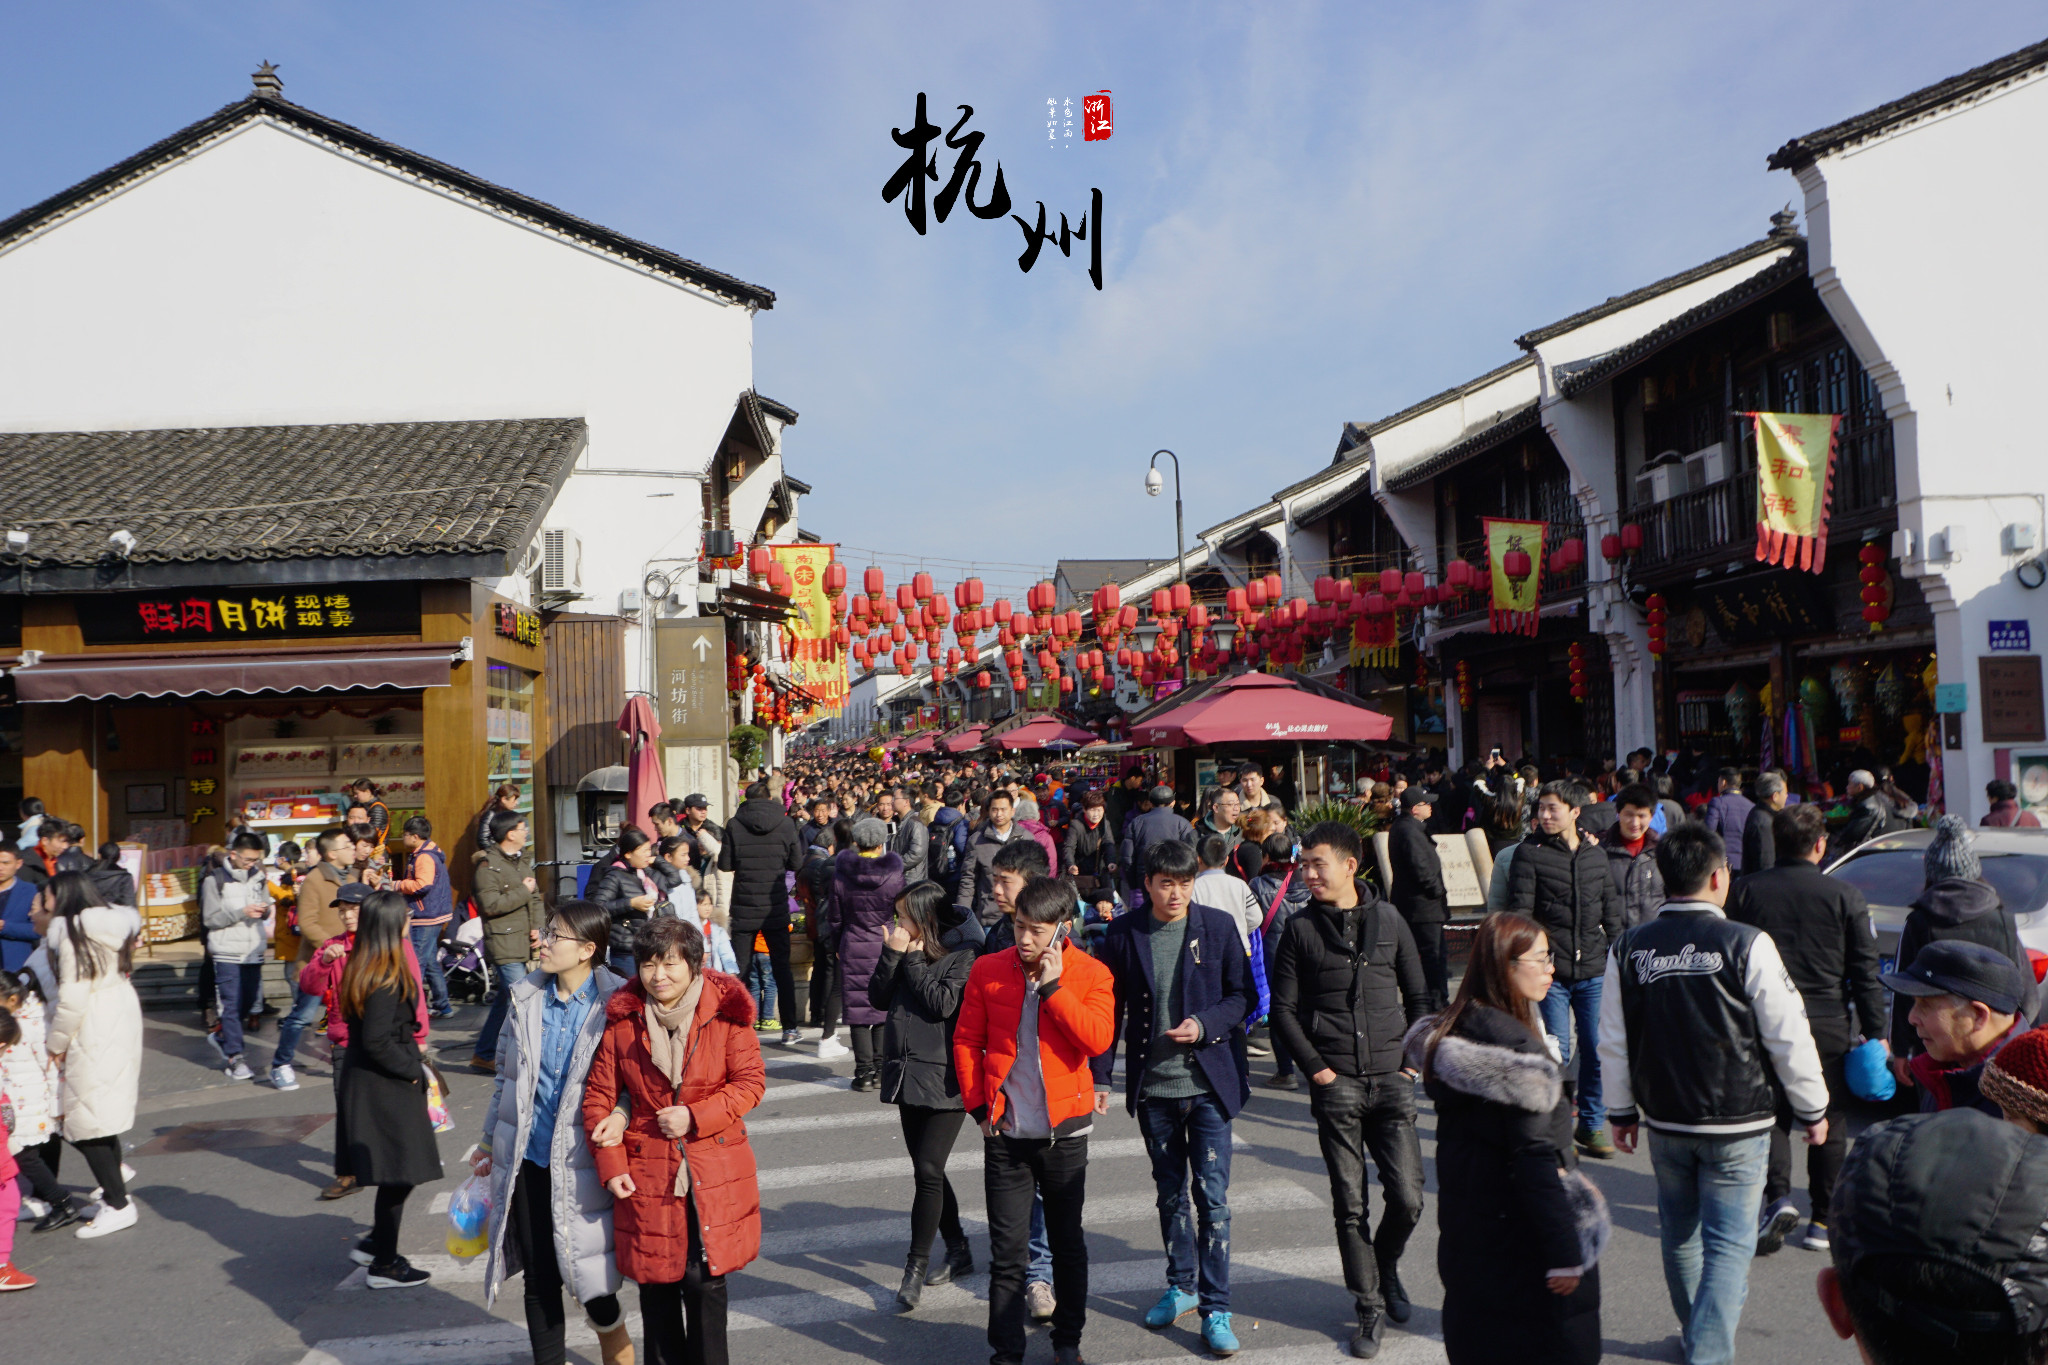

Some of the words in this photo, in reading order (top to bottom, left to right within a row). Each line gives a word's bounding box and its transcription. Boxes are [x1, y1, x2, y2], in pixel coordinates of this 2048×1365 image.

[138, 595, 288, 634] 鲜肉月饼
[294, 594, 350, 609] 现烤
[297, 611, 353, 627] 现卖
[671, 669, 688, 725] 河坊街
[190, 719, 217, 824] 杭州特产
[1631, 943, 1723, 984] Yankees
